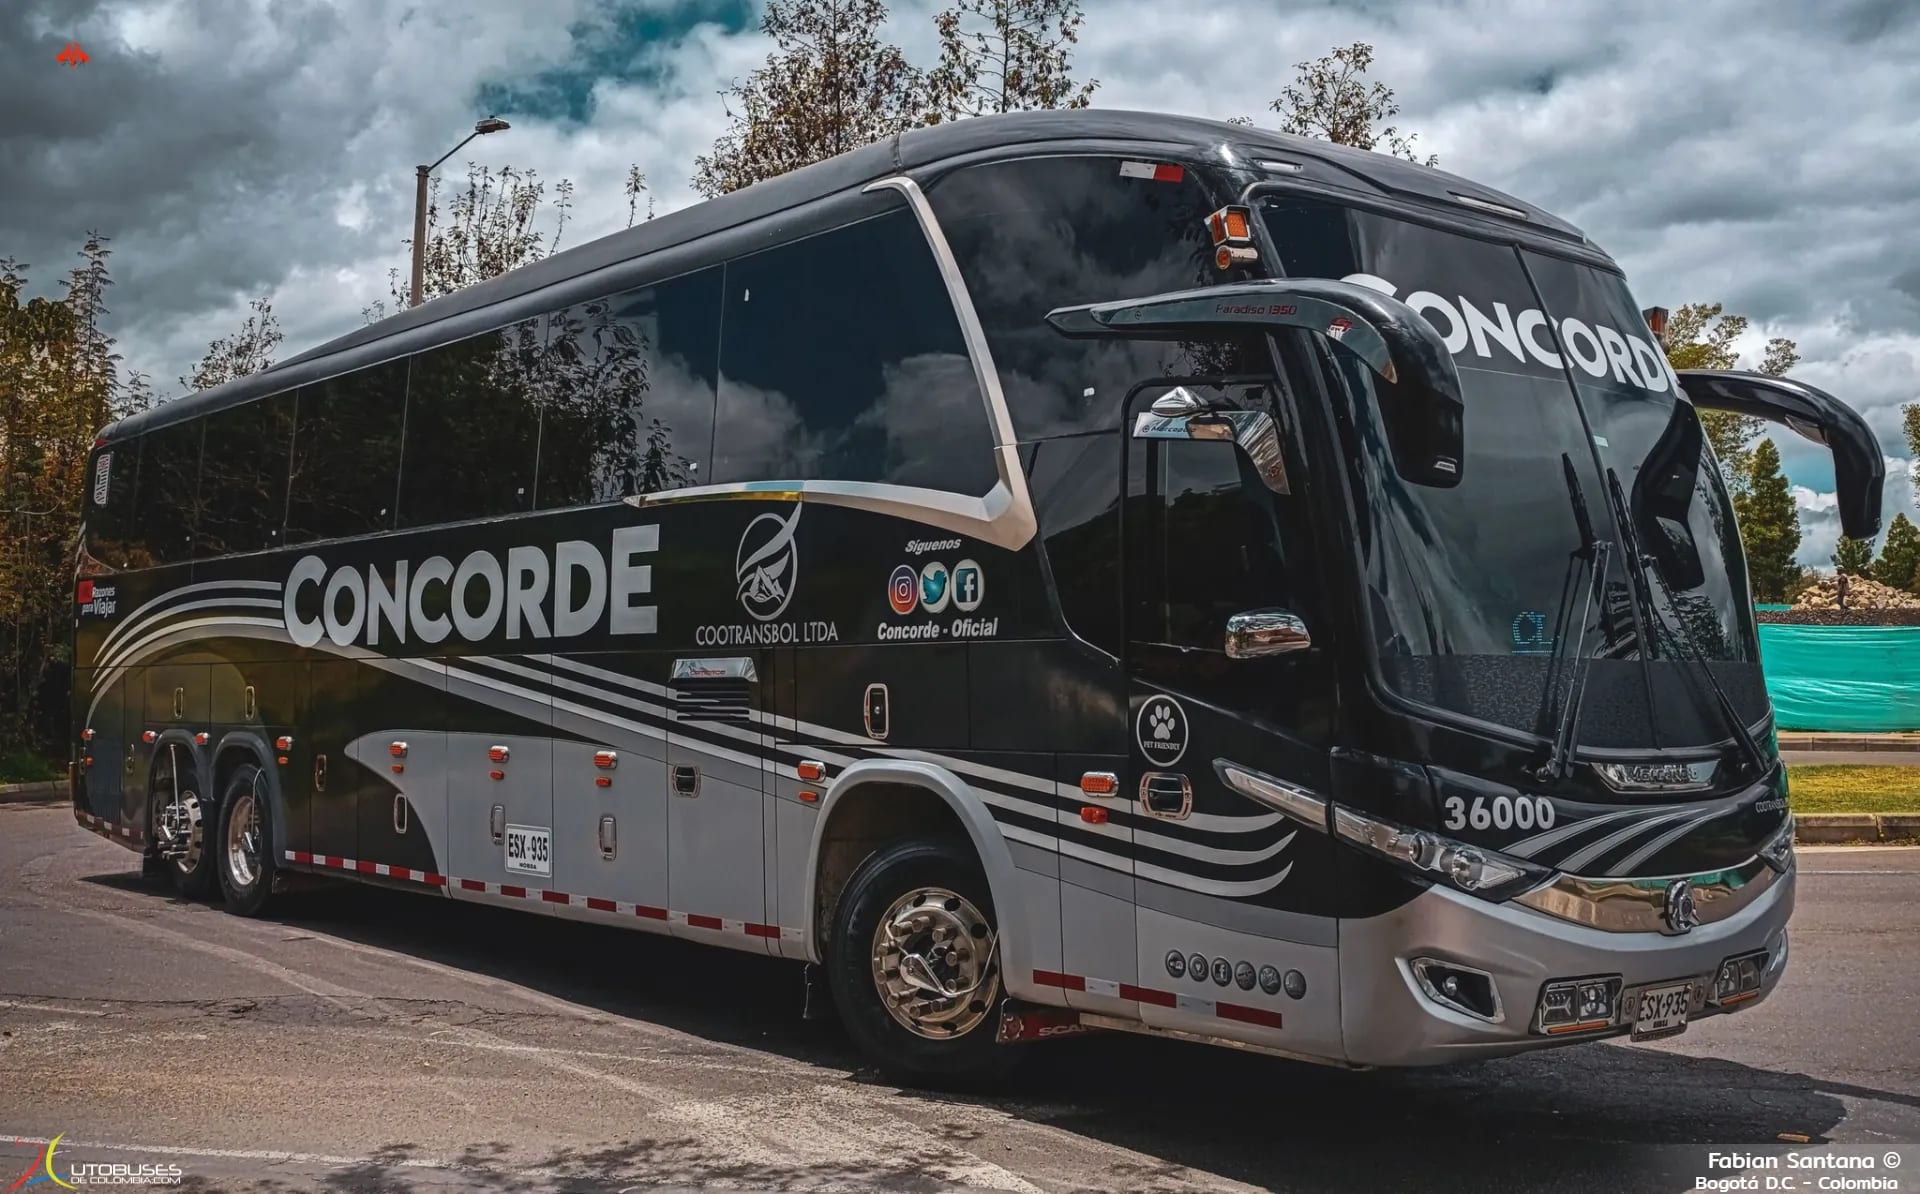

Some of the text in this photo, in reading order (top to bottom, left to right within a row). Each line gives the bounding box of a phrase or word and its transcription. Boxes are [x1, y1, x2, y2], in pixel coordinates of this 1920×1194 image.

[1215, 303, 1298, 316] Paradiso 1350
[904, 537, 962, 556] Síguenos
[283, 523, 660, 648] CONCORDE
[94, 597, 117, 619] Viajar
[695, 621, 839, 646] COOTRANSBOL LTDA
[877, 620, 940, 641] Concorde
[951, 617, 999, 638] Oficial
[1444, 795, 1556, 831] 36000
